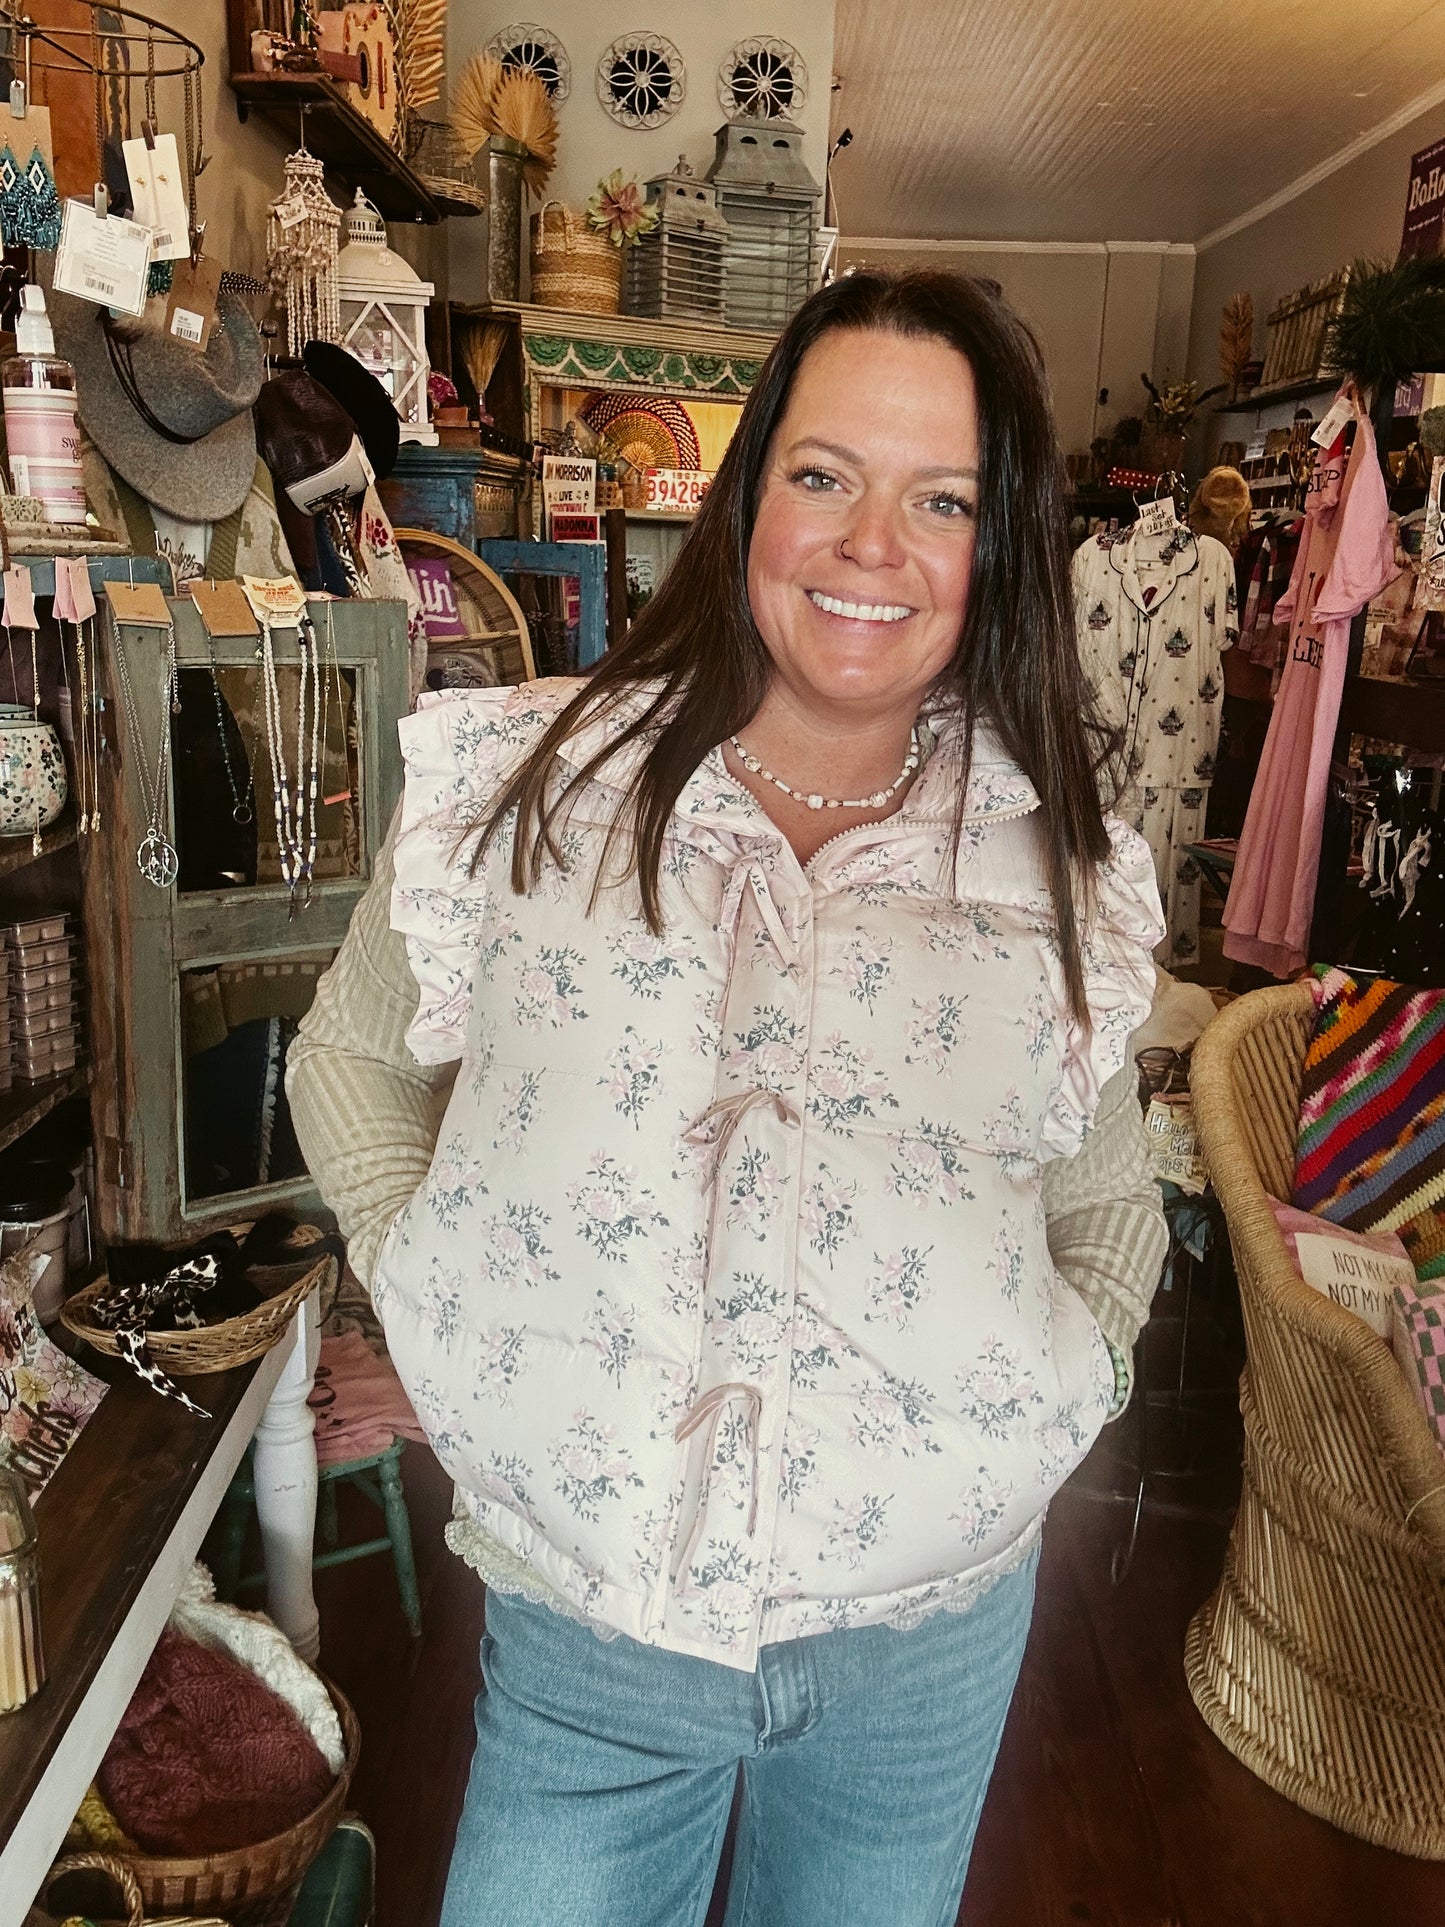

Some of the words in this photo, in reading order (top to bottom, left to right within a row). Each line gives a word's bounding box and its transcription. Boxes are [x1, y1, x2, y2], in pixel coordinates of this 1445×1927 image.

[555, 464, 592, 482] MORRISON
[559, 490, 573, 501] LIVE
[554, 517, 595, 533] MADONNA
[1332, 1250, 1361, 1277] NOT
[1361, 1257, 1382, 1281] MY
[1328, 1283, 1357, 1308] NOT
[1361, 1287, 1379, 1312] MY
